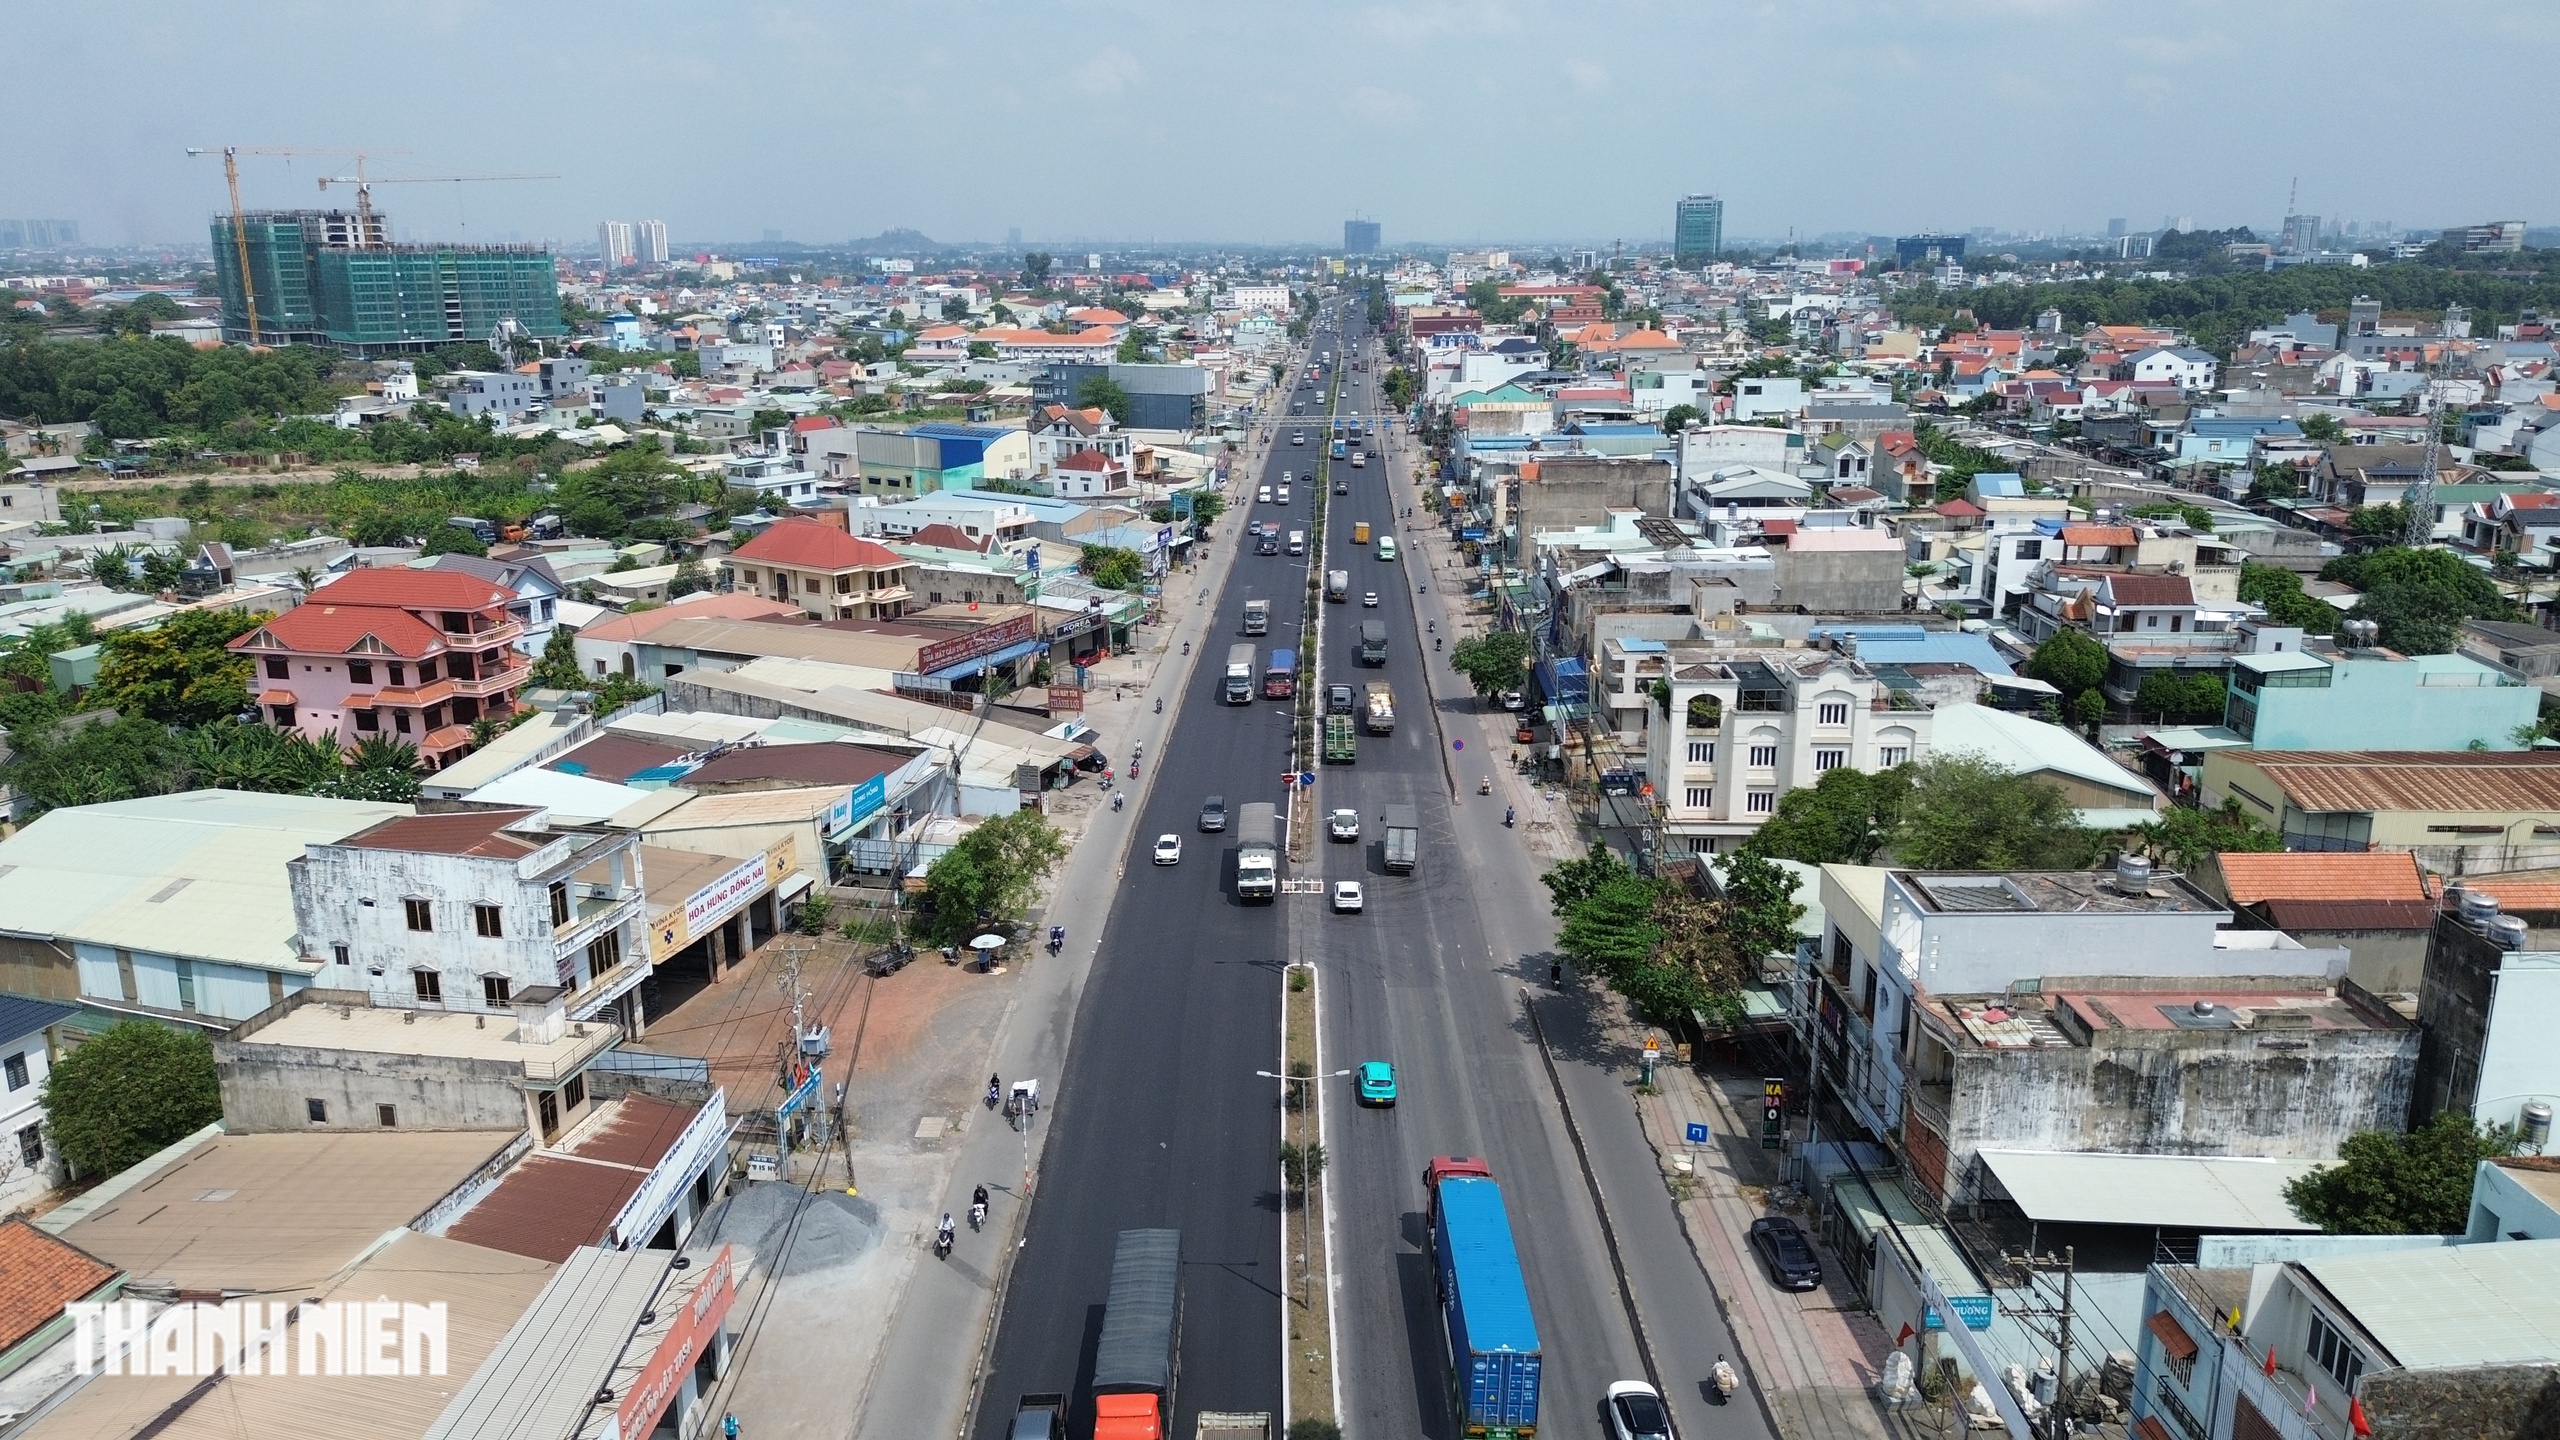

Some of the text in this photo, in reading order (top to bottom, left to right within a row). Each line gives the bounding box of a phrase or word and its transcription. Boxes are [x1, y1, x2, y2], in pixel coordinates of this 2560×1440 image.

[1063, 618, 1091, 633] KOREA
[687, 903, 705, 922] HÒA
[729, 873, 750, 895] ĐỒNG
[751, 865, 764, 881] NAI
[1766, 1084, 1782, 1095] KA
[1765, 1096, 1780, 1107] RA
[1768, 1109, 1778, 1120] O
